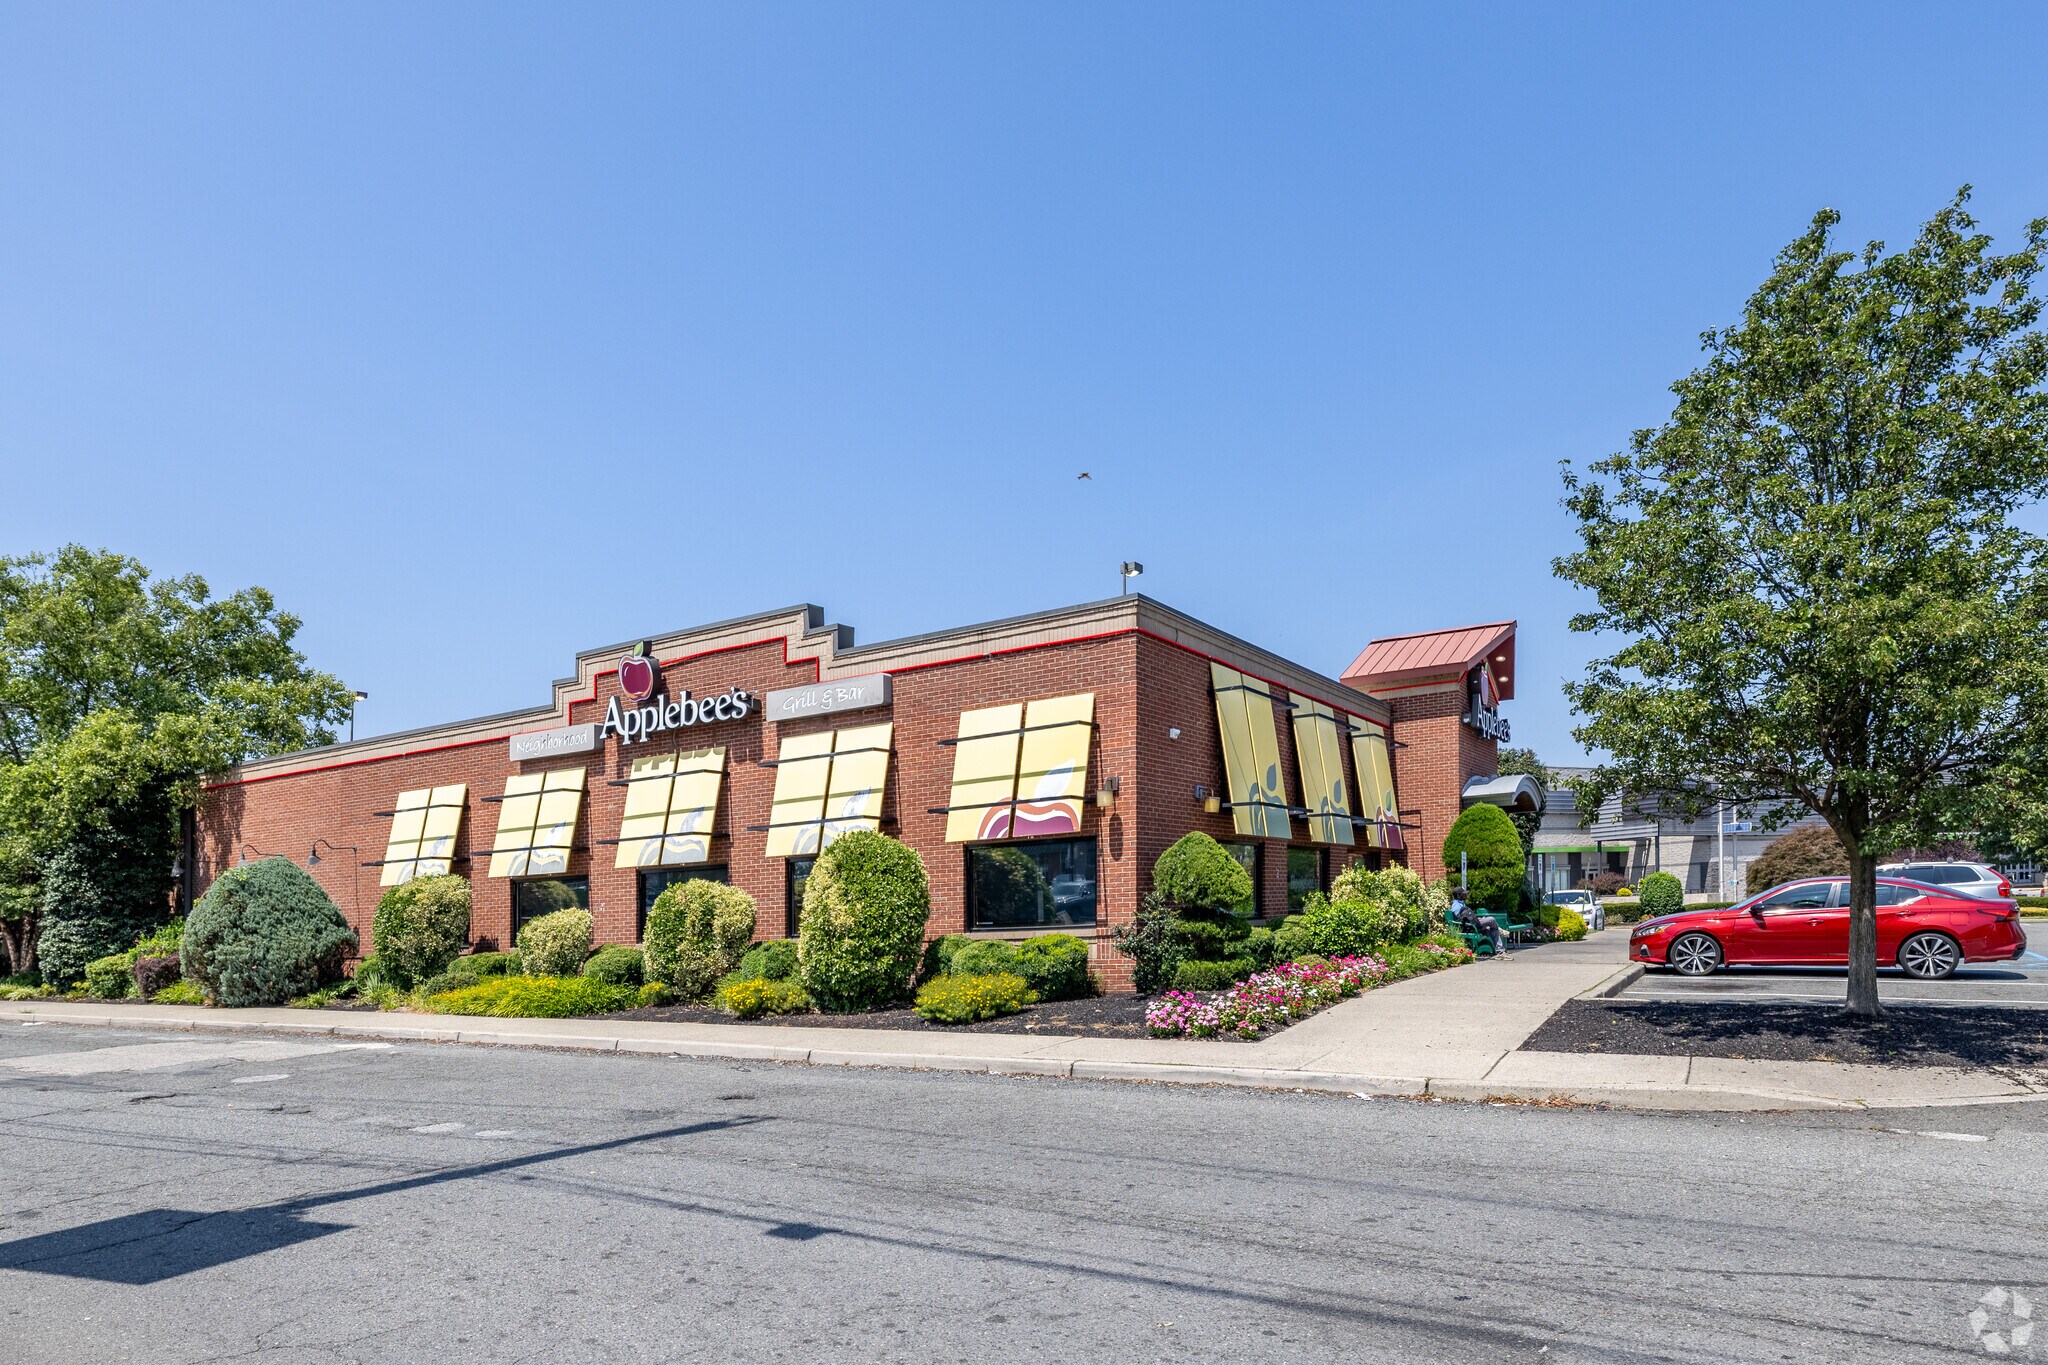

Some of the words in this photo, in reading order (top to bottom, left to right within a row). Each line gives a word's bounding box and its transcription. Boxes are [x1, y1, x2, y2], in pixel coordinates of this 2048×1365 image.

[782, 690, 818, 713] Grill
[821, 689, 833, 710] &
[836, 686, 866, 702] Bar
[600, 687, 748, 745] Applebee's
[516, 728, 588, 755] Neighborhood
